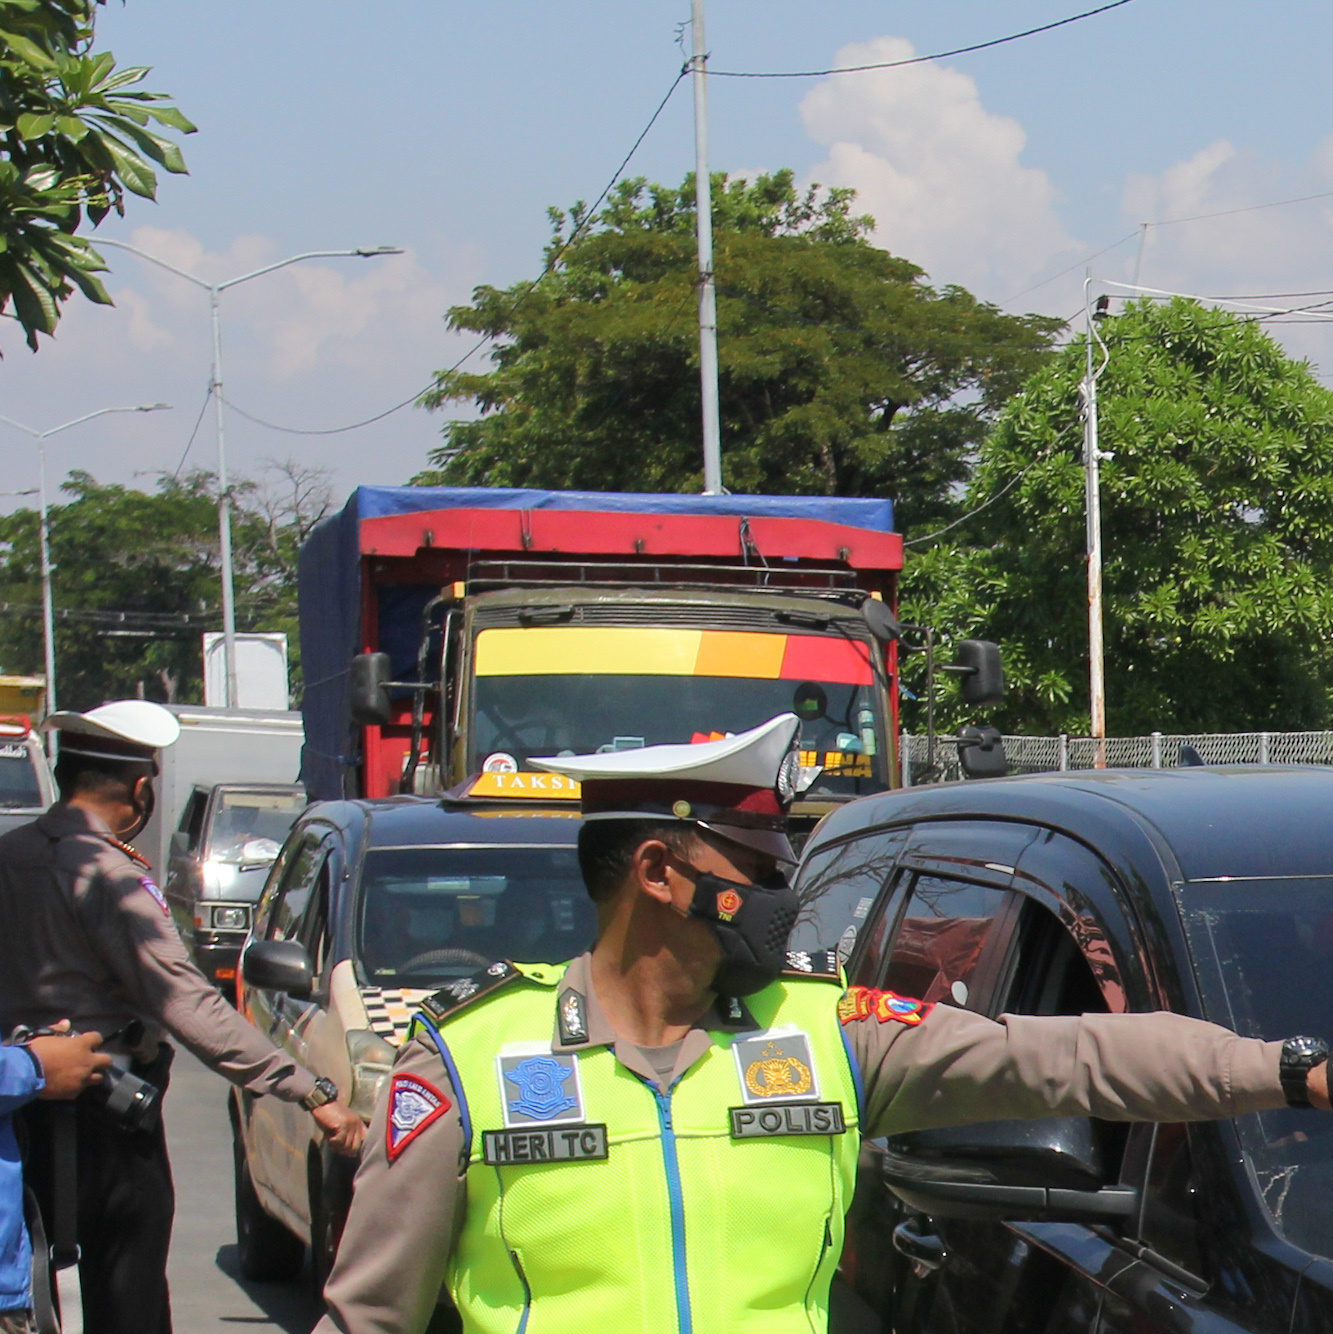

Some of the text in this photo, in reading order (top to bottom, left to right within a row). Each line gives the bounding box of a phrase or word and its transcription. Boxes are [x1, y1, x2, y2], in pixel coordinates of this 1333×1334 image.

[492, 774, 577, 790] TAKSI
[718, 911, 733, 922] TNI
[734, 1107, 840, 1134] POLISI
[495, 1130, 597, 1160] HERI TC
